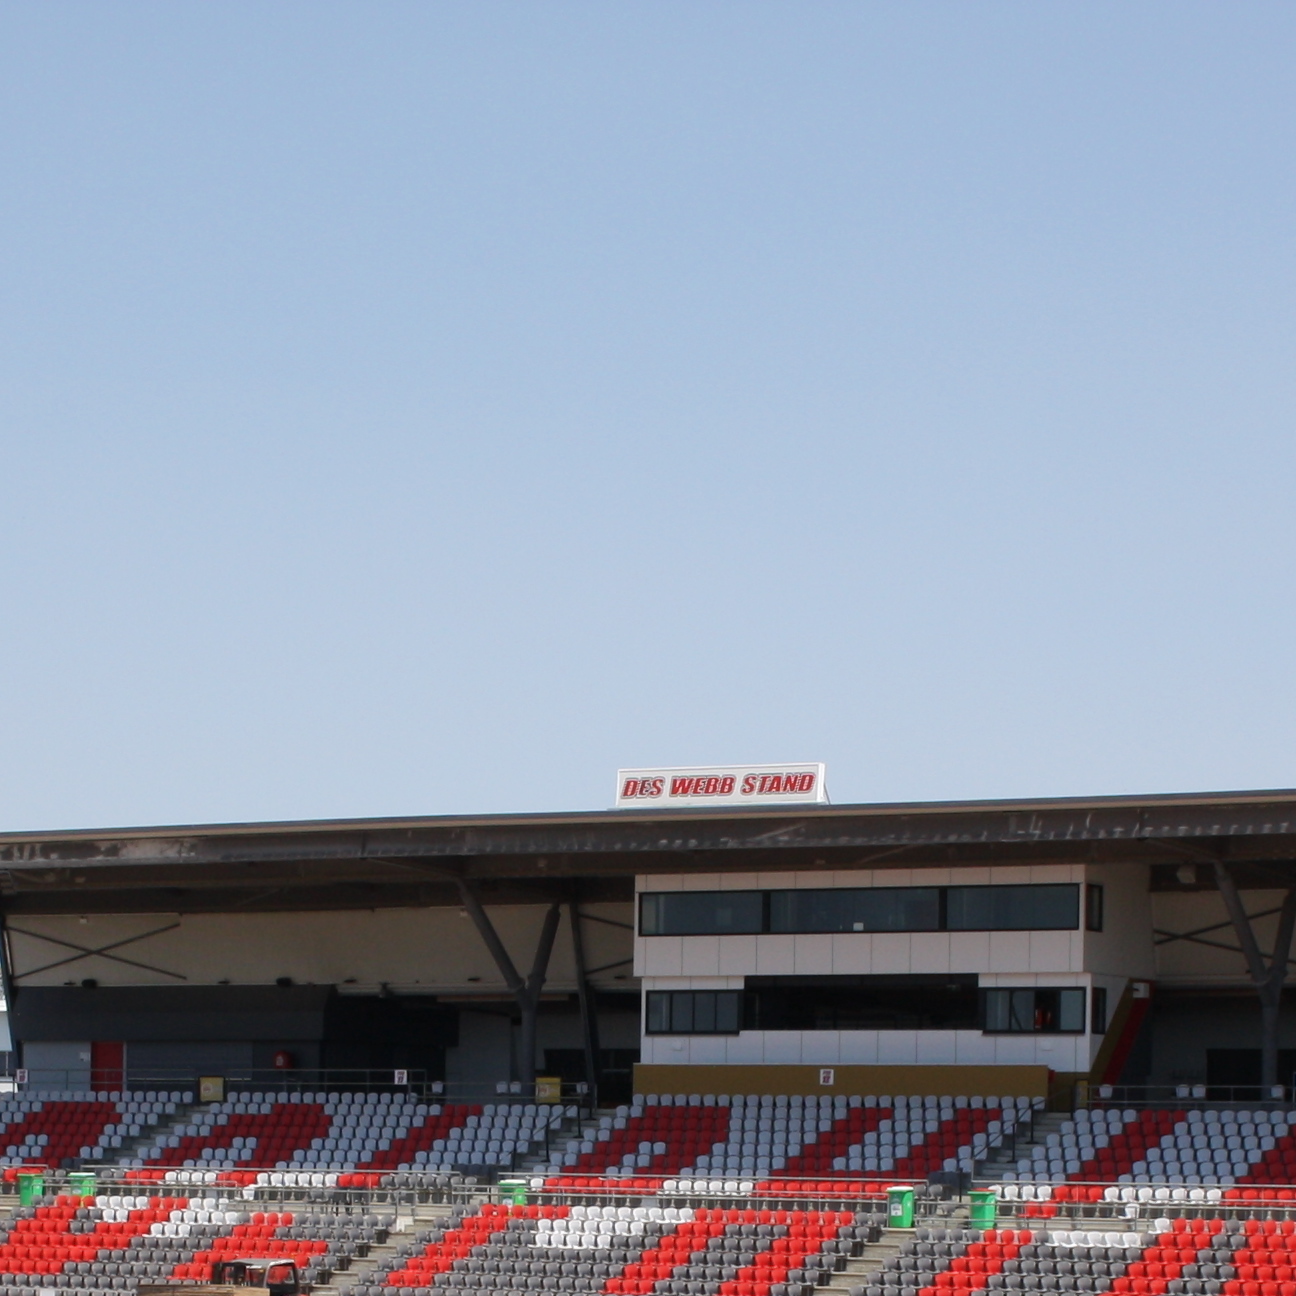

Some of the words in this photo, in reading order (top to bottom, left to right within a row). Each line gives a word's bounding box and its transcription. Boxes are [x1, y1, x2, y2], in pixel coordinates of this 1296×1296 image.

[621, 777, 664, 798] DES
[669, 774, 736, 797] WEBB
[741, 772, 816, 795] STAND
